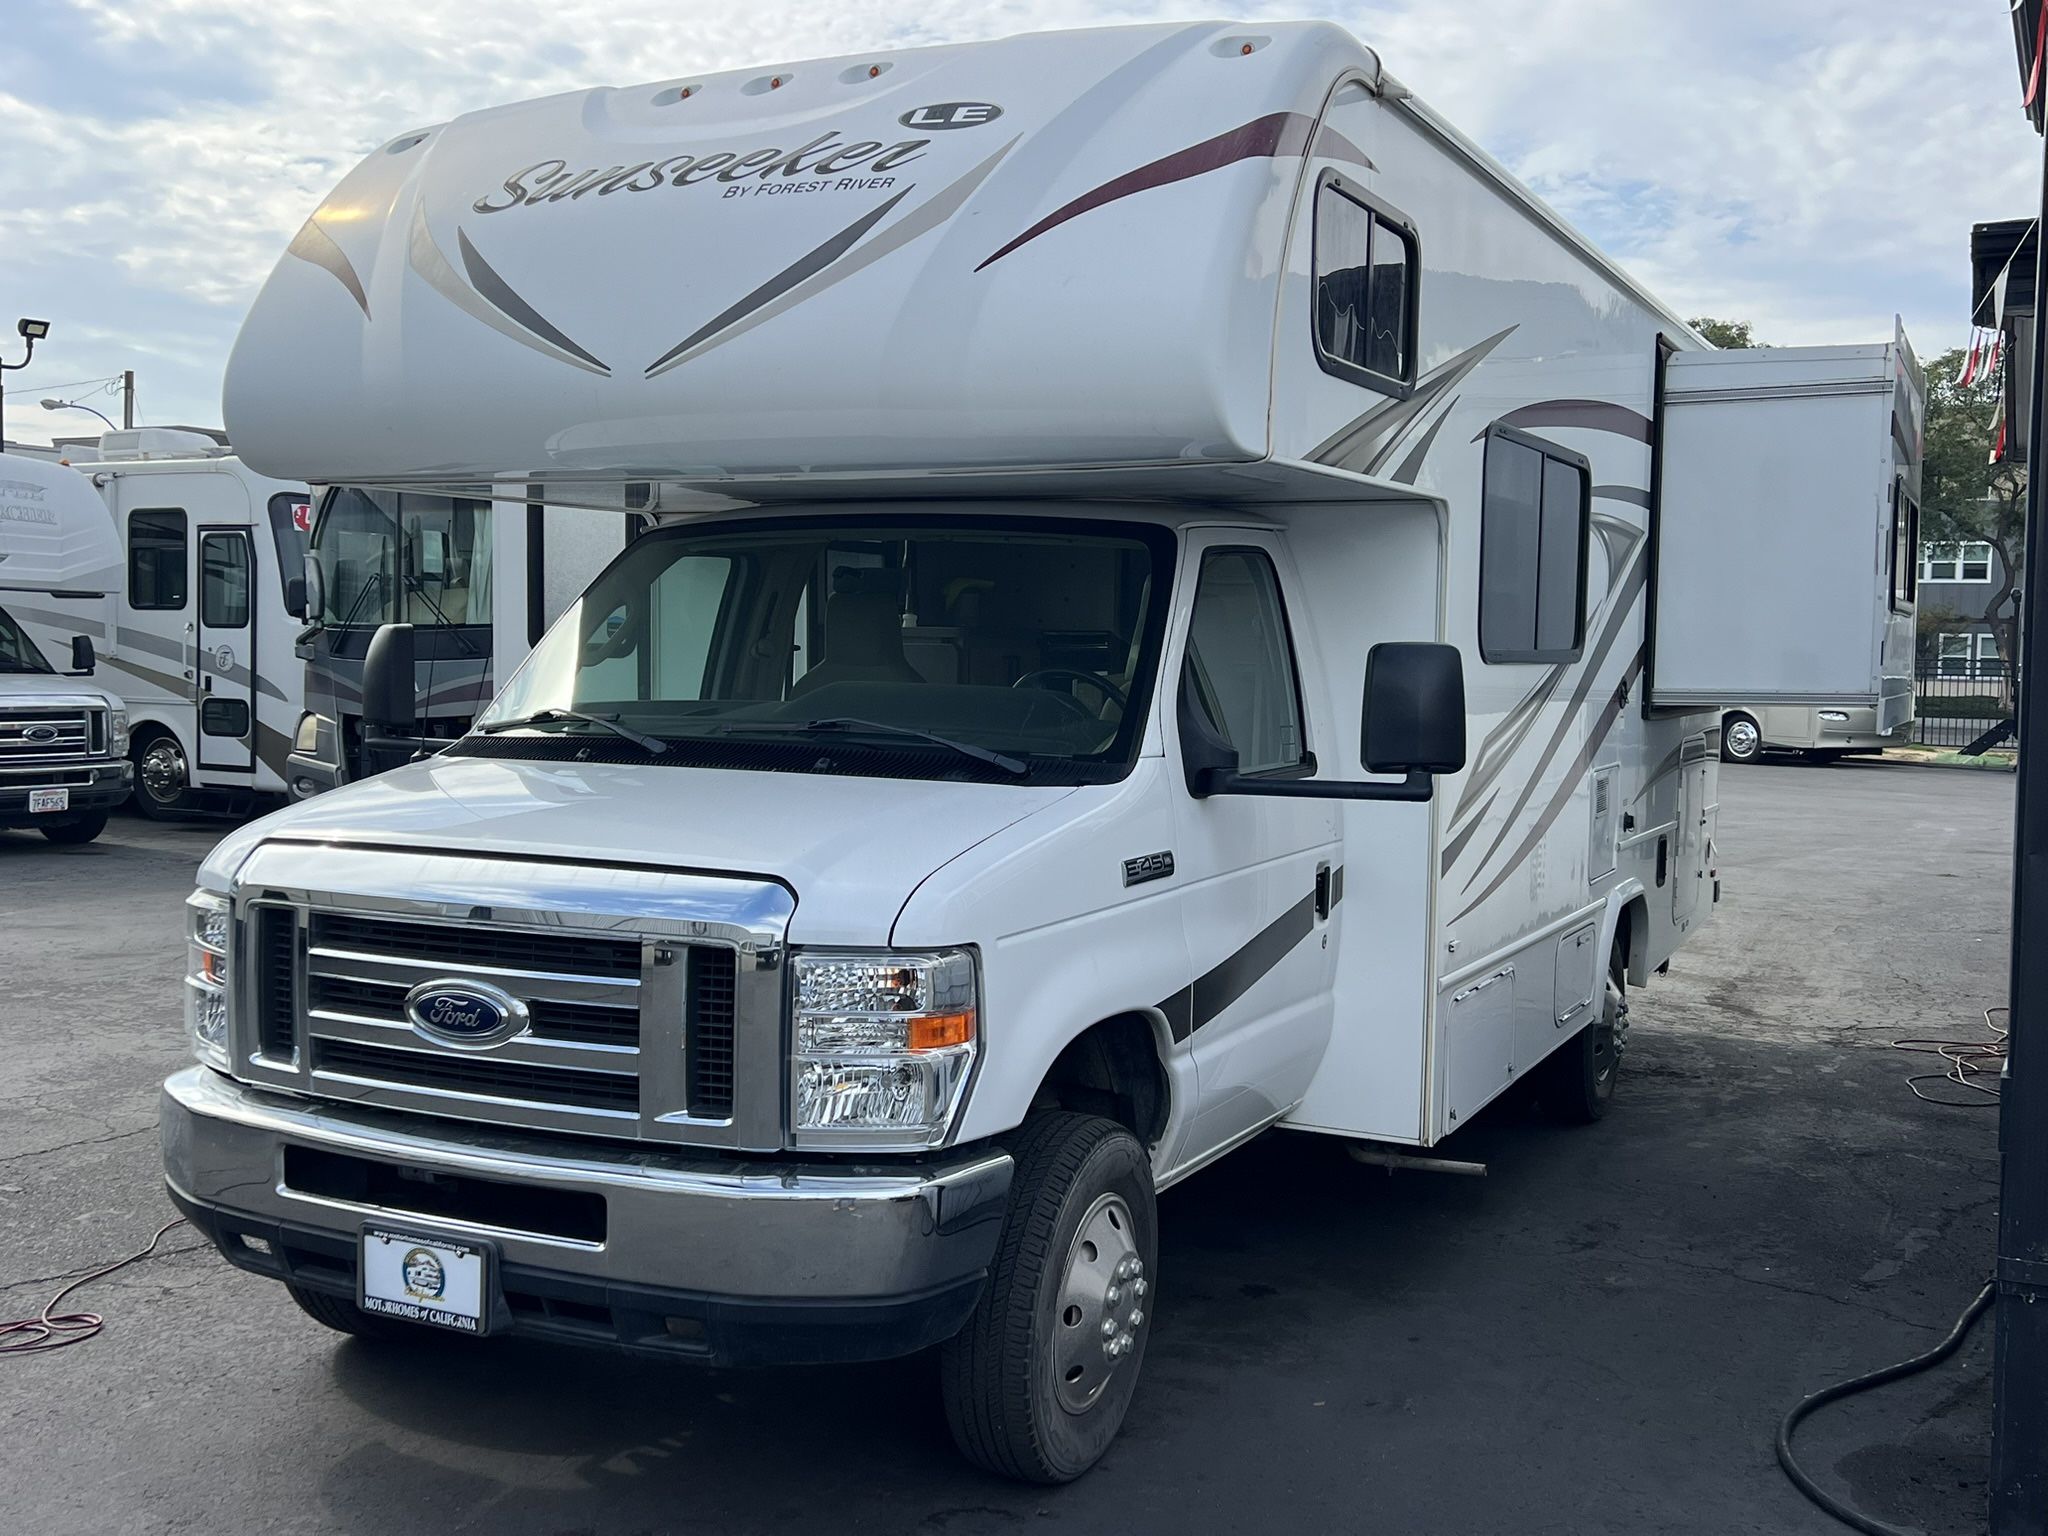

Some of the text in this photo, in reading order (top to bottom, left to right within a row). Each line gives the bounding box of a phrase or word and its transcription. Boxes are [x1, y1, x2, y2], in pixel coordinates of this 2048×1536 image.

[908, 105, 993, 124] LE
[472, 131, 932, 214] Sunseeker
[721, 177, 896, 198] BY FOREST RIVER
[1126, 853, 1173, 877] E-450
[429, 997, 481, 1027] Ford
[420, 1308, 430, 1321] of
